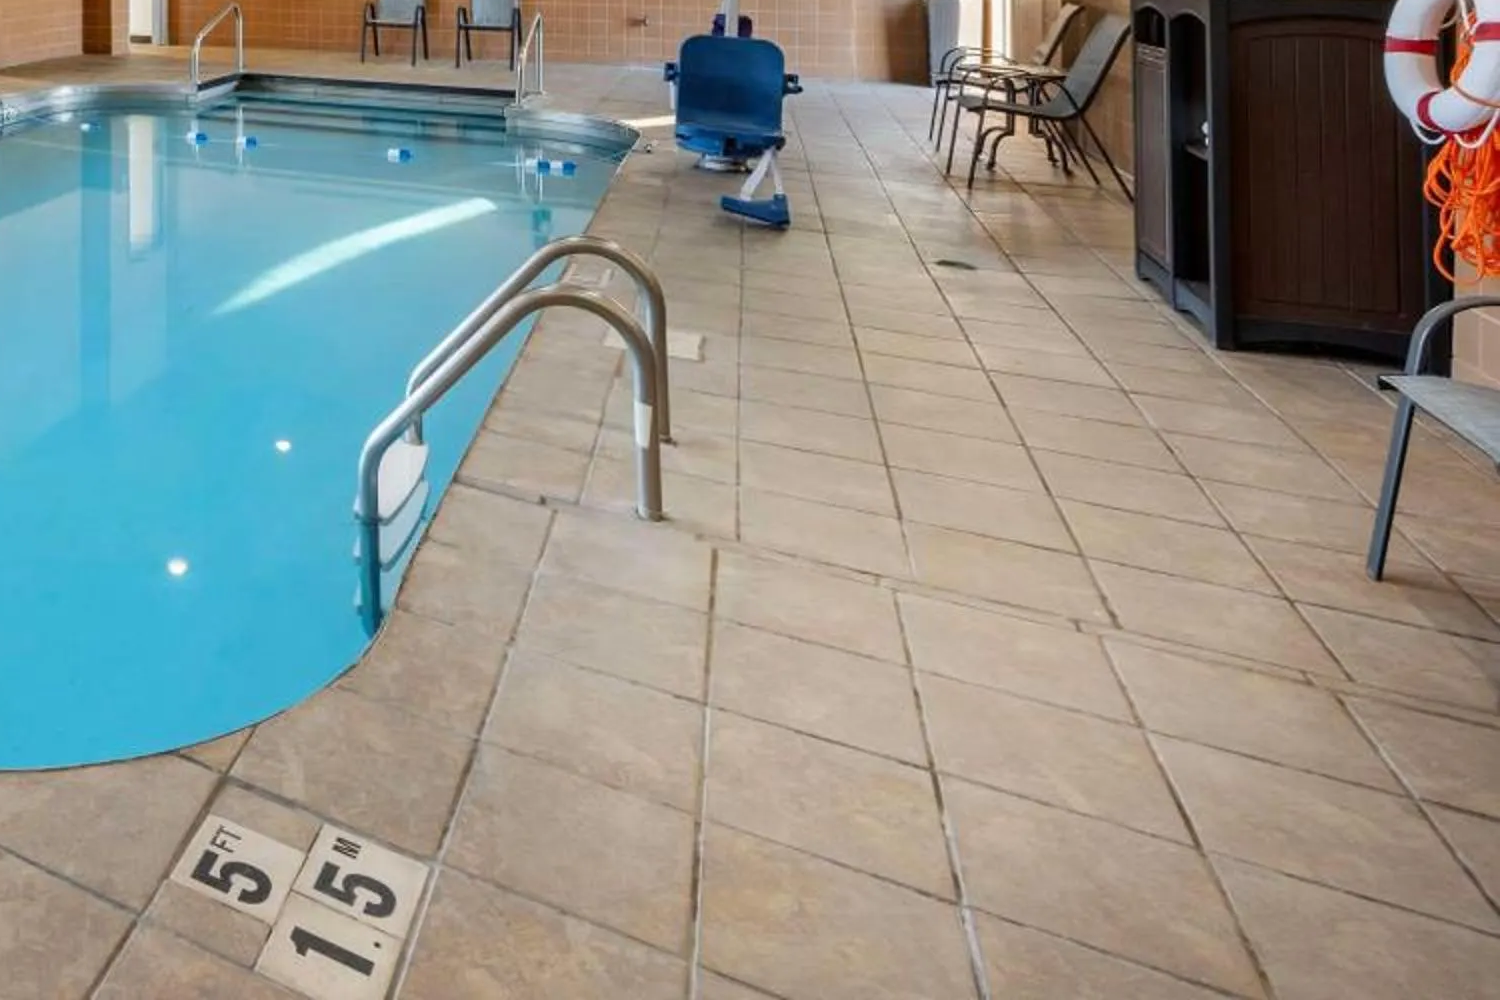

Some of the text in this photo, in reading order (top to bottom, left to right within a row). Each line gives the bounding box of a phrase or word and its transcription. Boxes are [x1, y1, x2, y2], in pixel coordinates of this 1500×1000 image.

[191, 825, 272, 905] 5 FT
[332, 837, 362, 859] M
